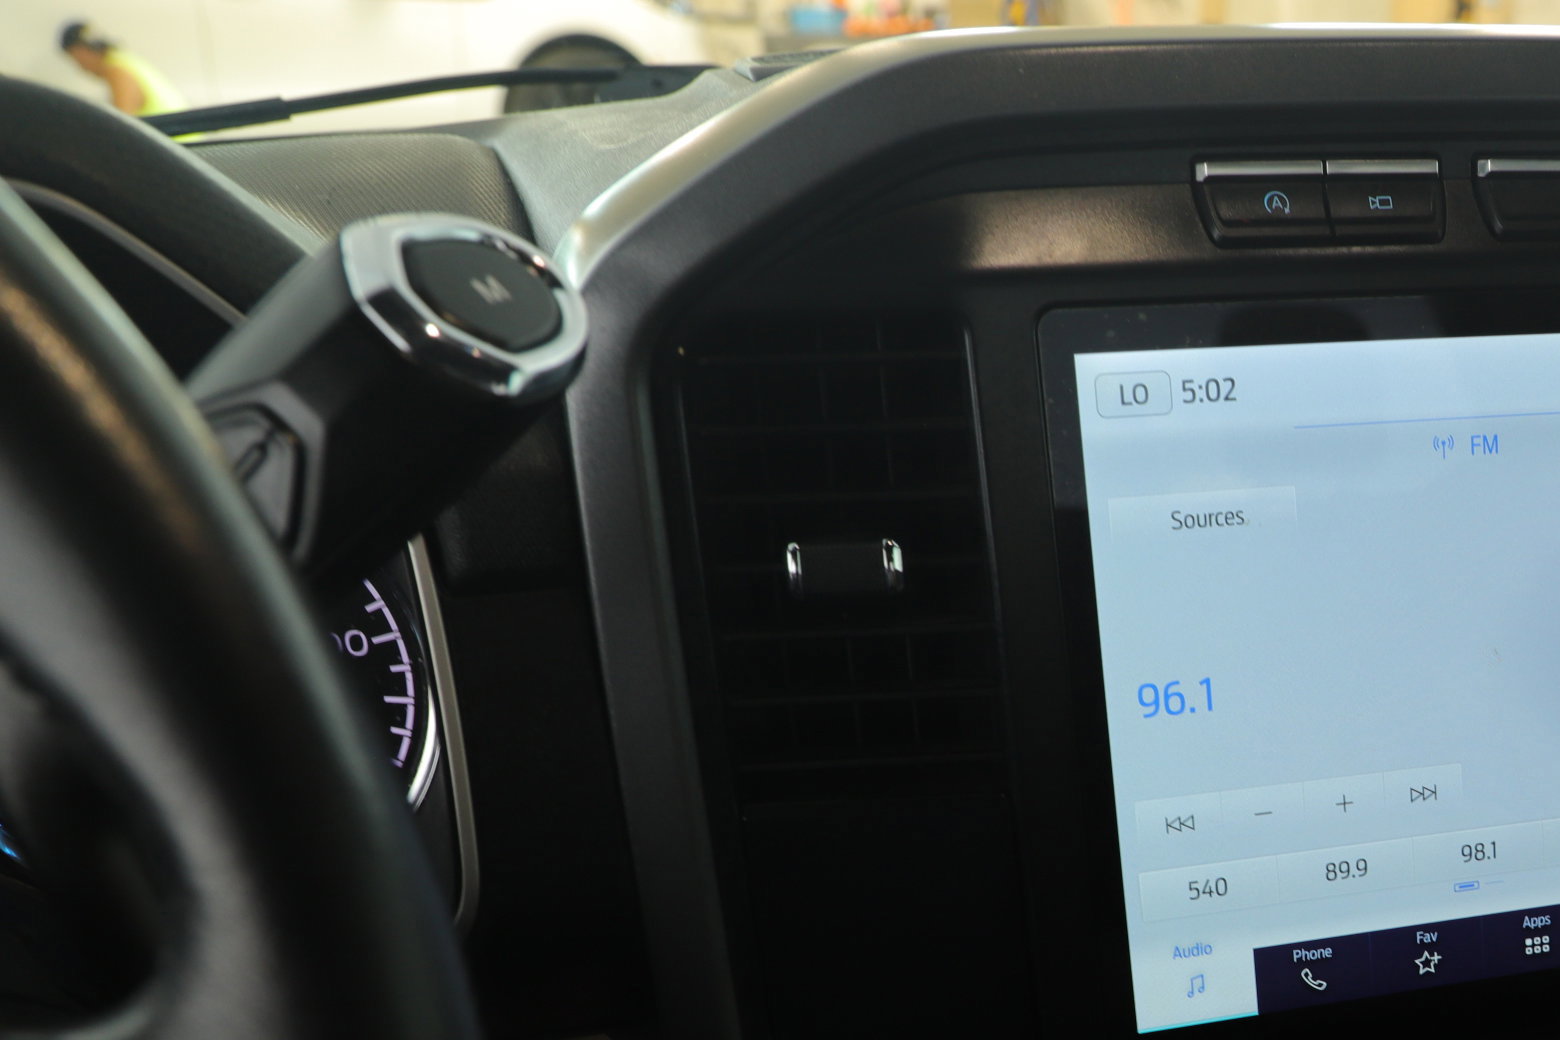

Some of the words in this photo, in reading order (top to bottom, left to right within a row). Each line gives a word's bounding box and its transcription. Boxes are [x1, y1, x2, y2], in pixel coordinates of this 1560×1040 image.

[1119, 383, 1149, 406] LO
[1181, 377, 1237, 403] 5:02
[1470, 433, 1500, 455] FM
[1170, 508, 1246, 531] Sources
[1136, 677, 1215, 719] 96.1
[1188, 877, 1228, 900] 540
[1325, 858, 1369, 882] 89.9
[1460, 841, 1498, 863] 98.1
[1172, 941, 1213, 960] Audio
[1292, 944, 1333, 963] Phone
[1416, 929, 1438, 945] Fav
[1522, 913, 1552, 930] Apps
